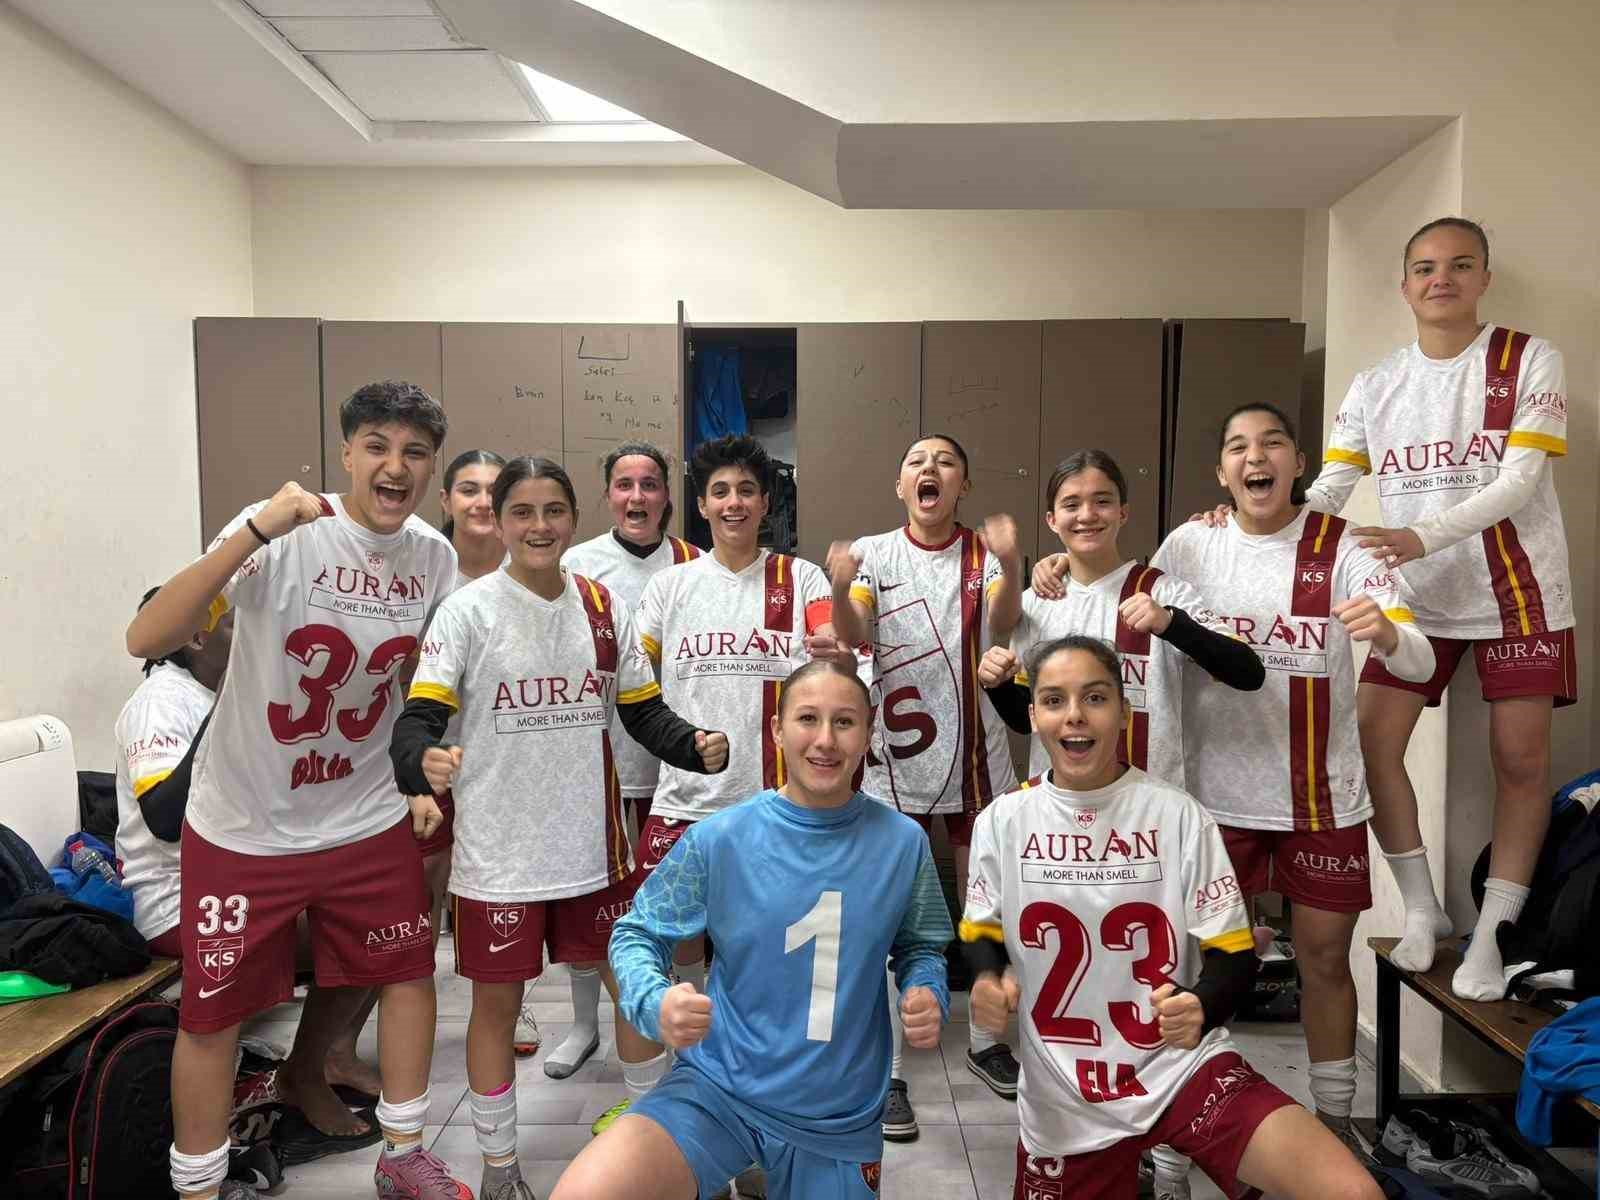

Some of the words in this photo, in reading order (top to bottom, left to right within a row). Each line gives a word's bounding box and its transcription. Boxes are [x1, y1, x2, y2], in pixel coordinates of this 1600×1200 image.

[1486, 386, 1509, 398] KS
[1377, 432, 1510, 476] AURAN
[1401, 479, 1434, 490] MORE
[1436, 475, 1463, 486] THAN
[1302, 570, 1325, 584] KS
[770, 594, 787, 605] KS
[361, 604, 386, 616] THAN
[595, 628, 614, 640] KS
[1219, 613, 1329, 651] RAN
[675, 627, 793, 660] AURAN
[1486, 639, 1561, 662] AURAN
[693, 663, 718, 673] MORE
[719, 663, 744, 672] THAN
[745, 664, 772, 673] SMELL
[1267, 655, 1300, 667] SMELL
[491, 668, 615, 711] AURAN
[516, 715, 550, 728] MORE
[552, 712, 579, 724] THAN
[1020, 828, 1159, 863] AURAN
[1042, 869, 1073, 880] MORE
[1075, 871, 1104, 881] THAN
[1105, 869, 1138, 880] SMELL
[1194, 875, 1239, 909] AUR
[197, 894, 249, 935] 33
[493, 911, 519, 925] KS
[204, 951, 235, 968] KS
[784, 891, 842, 1042] 1
[1019, 901, 1178, 1050] 23
[1075, 1058, 1150, 1104] ELA
